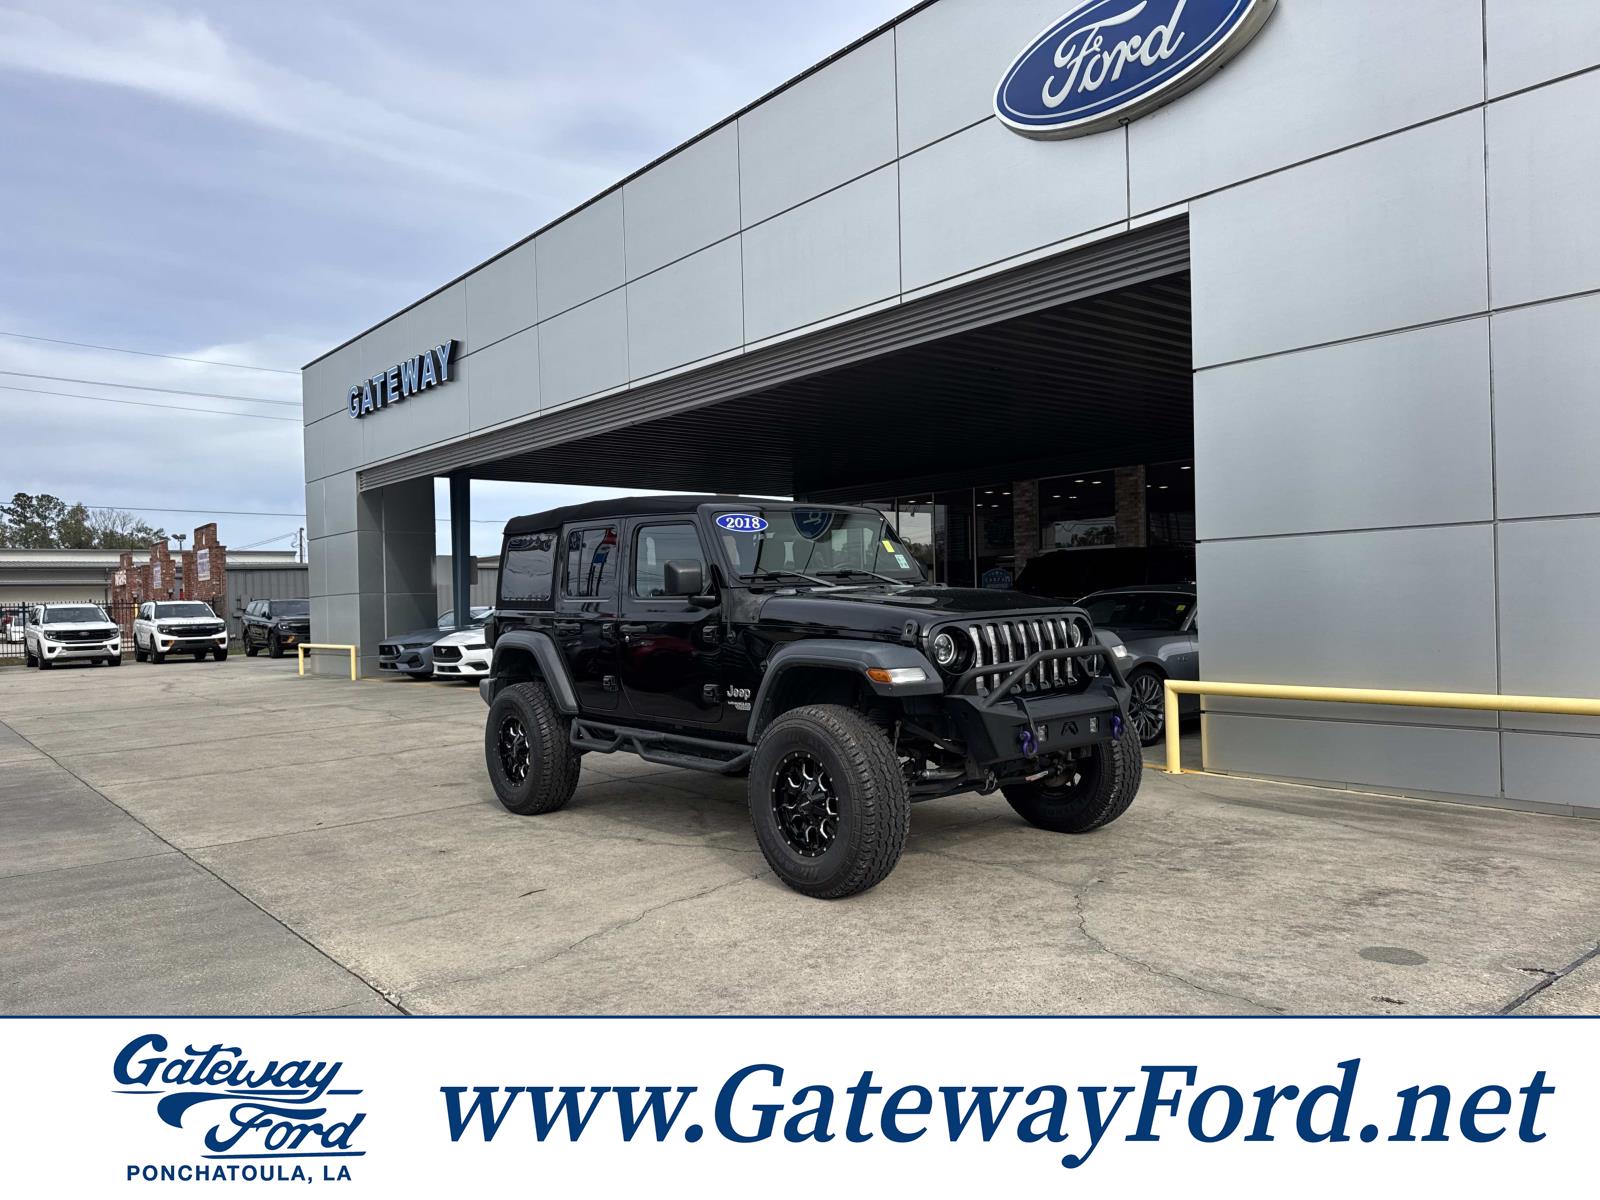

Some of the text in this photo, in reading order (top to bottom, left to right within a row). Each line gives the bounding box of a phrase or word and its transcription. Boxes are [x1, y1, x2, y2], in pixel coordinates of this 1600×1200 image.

[1042, 0, 1185, 108] Ford
[347, 339, 457, 419] GATEWAY
[726, 517, 760, 529] 2018
[726, 684, 751, 701] Jeep
